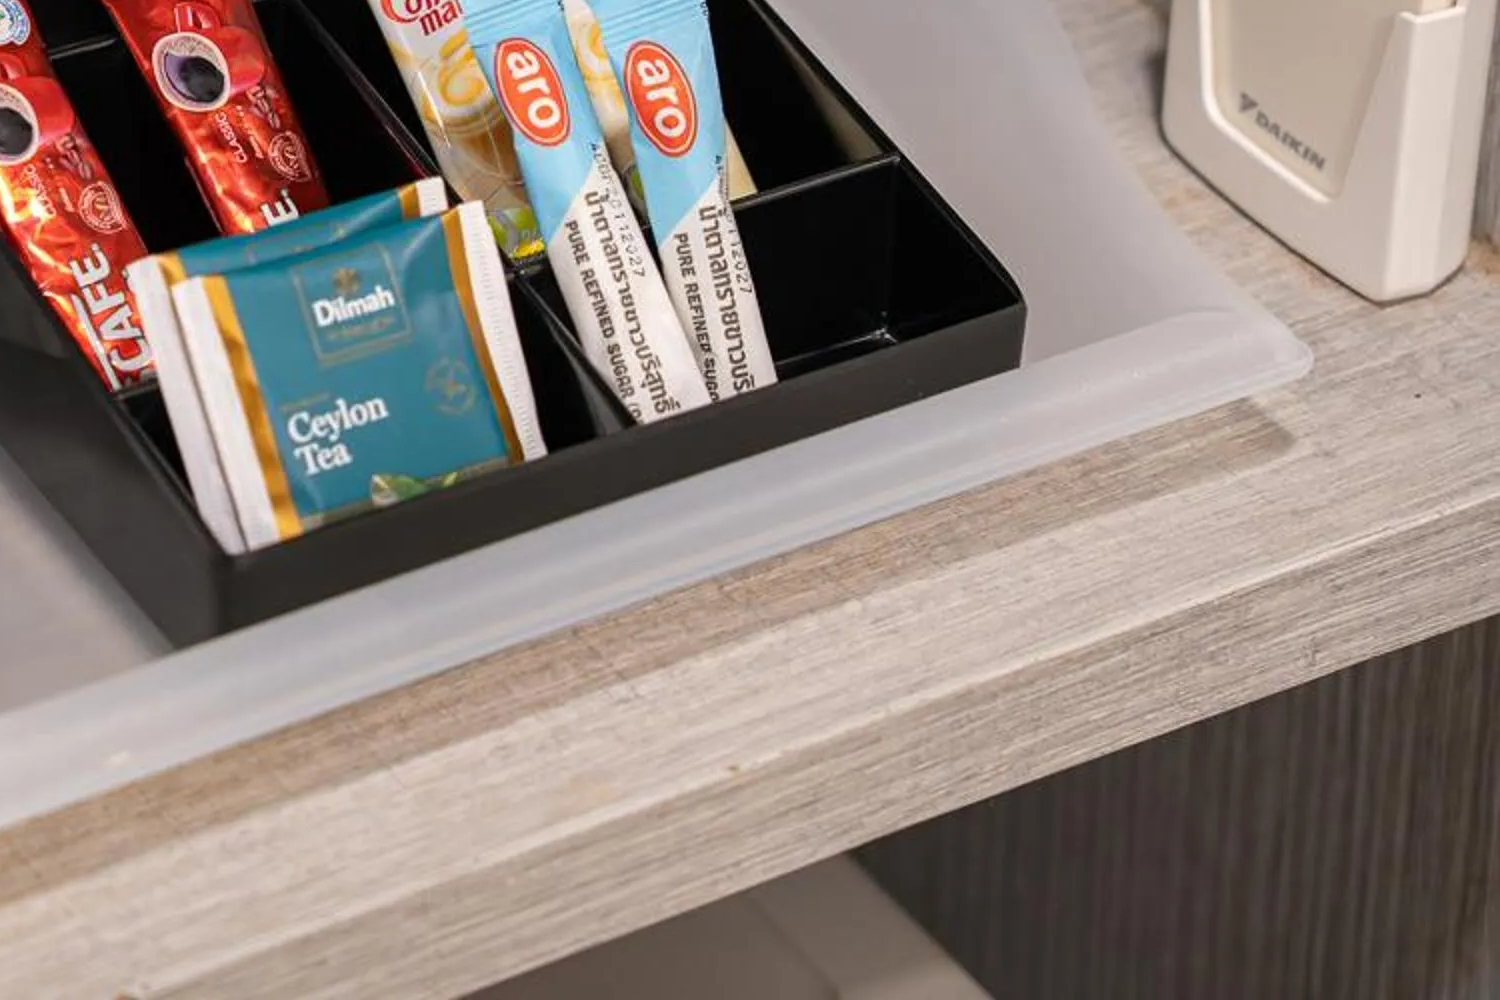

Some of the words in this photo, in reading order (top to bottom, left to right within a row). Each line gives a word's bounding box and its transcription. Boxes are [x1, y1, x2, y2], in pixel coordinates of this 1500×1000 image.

[506, 49, 562, 132] aro
[636, 58, 688, 138] aro
[1255, 109, 1326, 172] DAIKIN
[673, 230, 697, 278] PURE
[312, 285, 396, 328] Dilmah
[565, 218, 590, 264] PURE
[581, 265, 616, 339] REFINED
[606, 340, 635, 400] SUGAR
[287, 395, 389, 445] Ceylon
[294, 442, 354, 476] Tea
